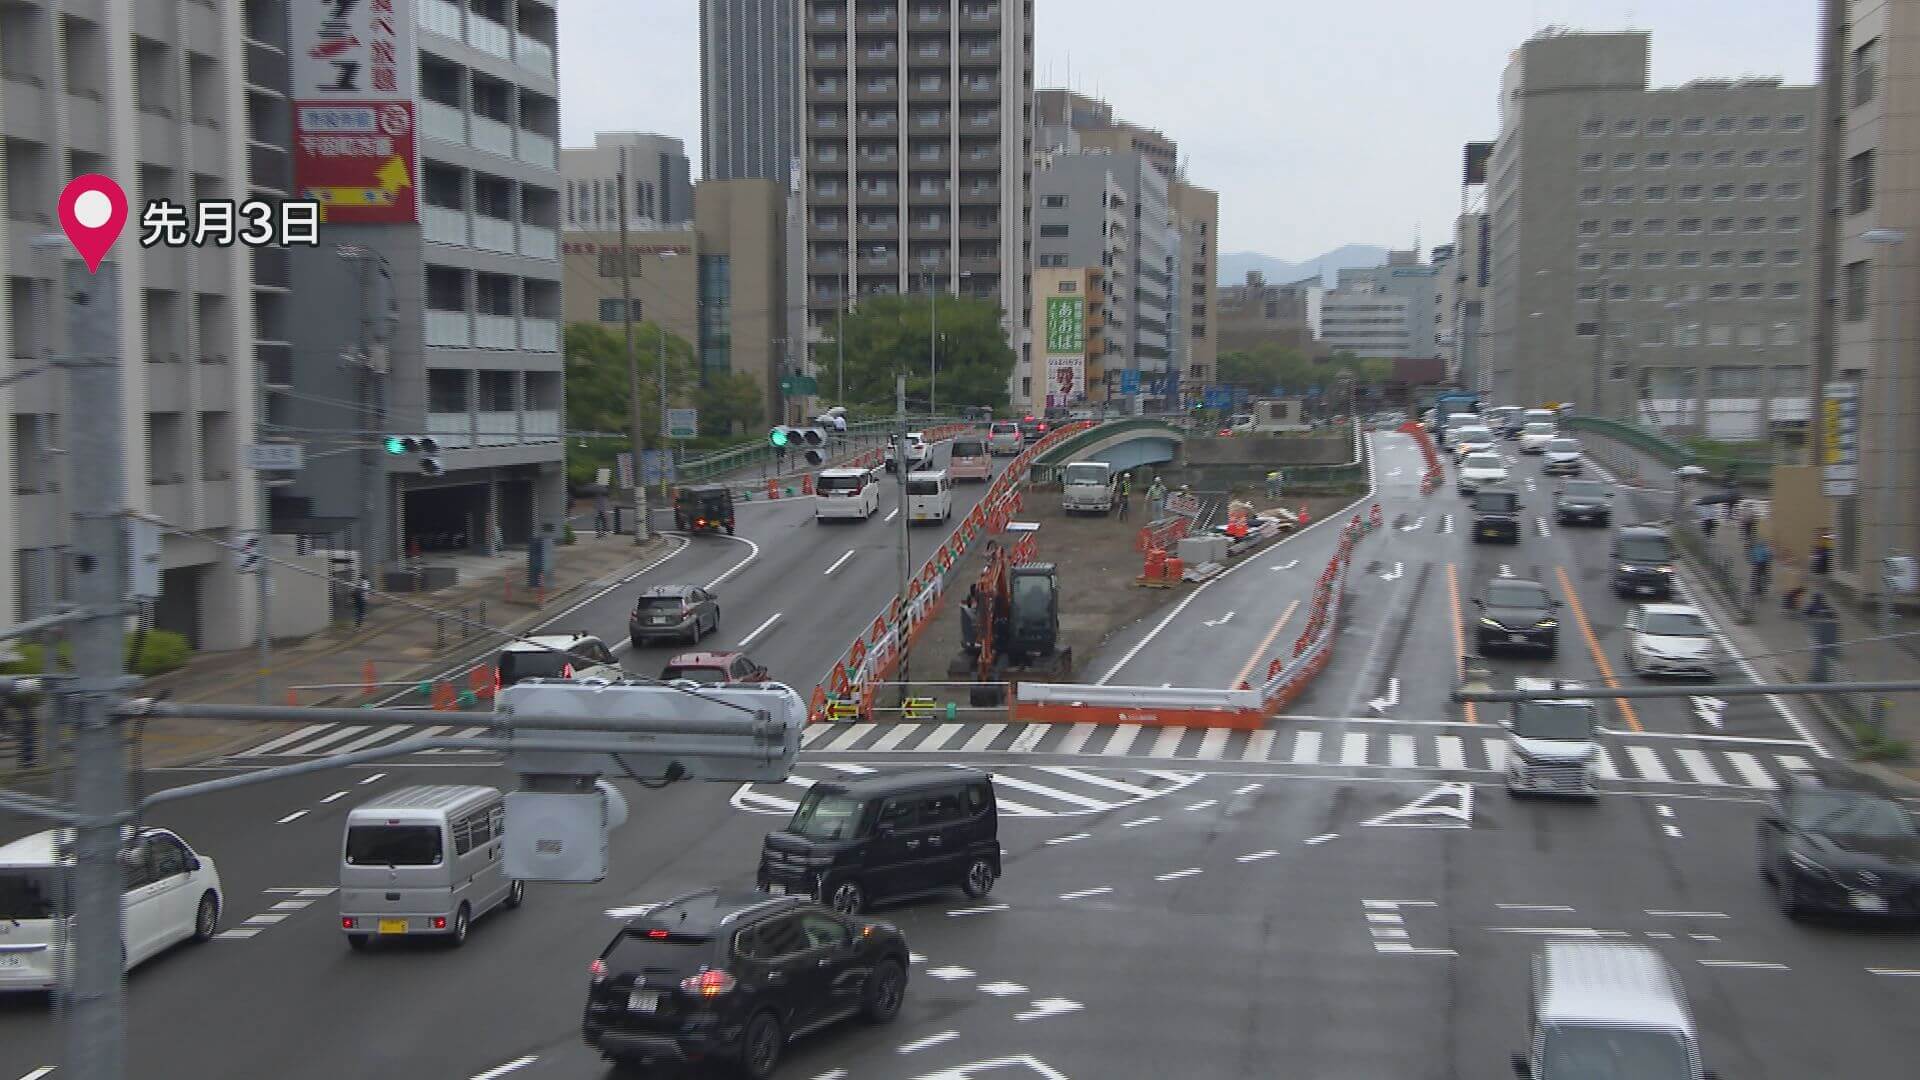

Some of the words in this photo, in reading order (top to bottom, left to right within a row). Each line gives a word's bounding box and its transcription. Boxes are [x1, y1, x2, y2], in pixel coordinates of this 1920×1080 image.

[305, 111, 371, 128] 市役所前
[301, 136, 394, 157] 千田町方面
[1058, 302, 1072, 350] あおば
